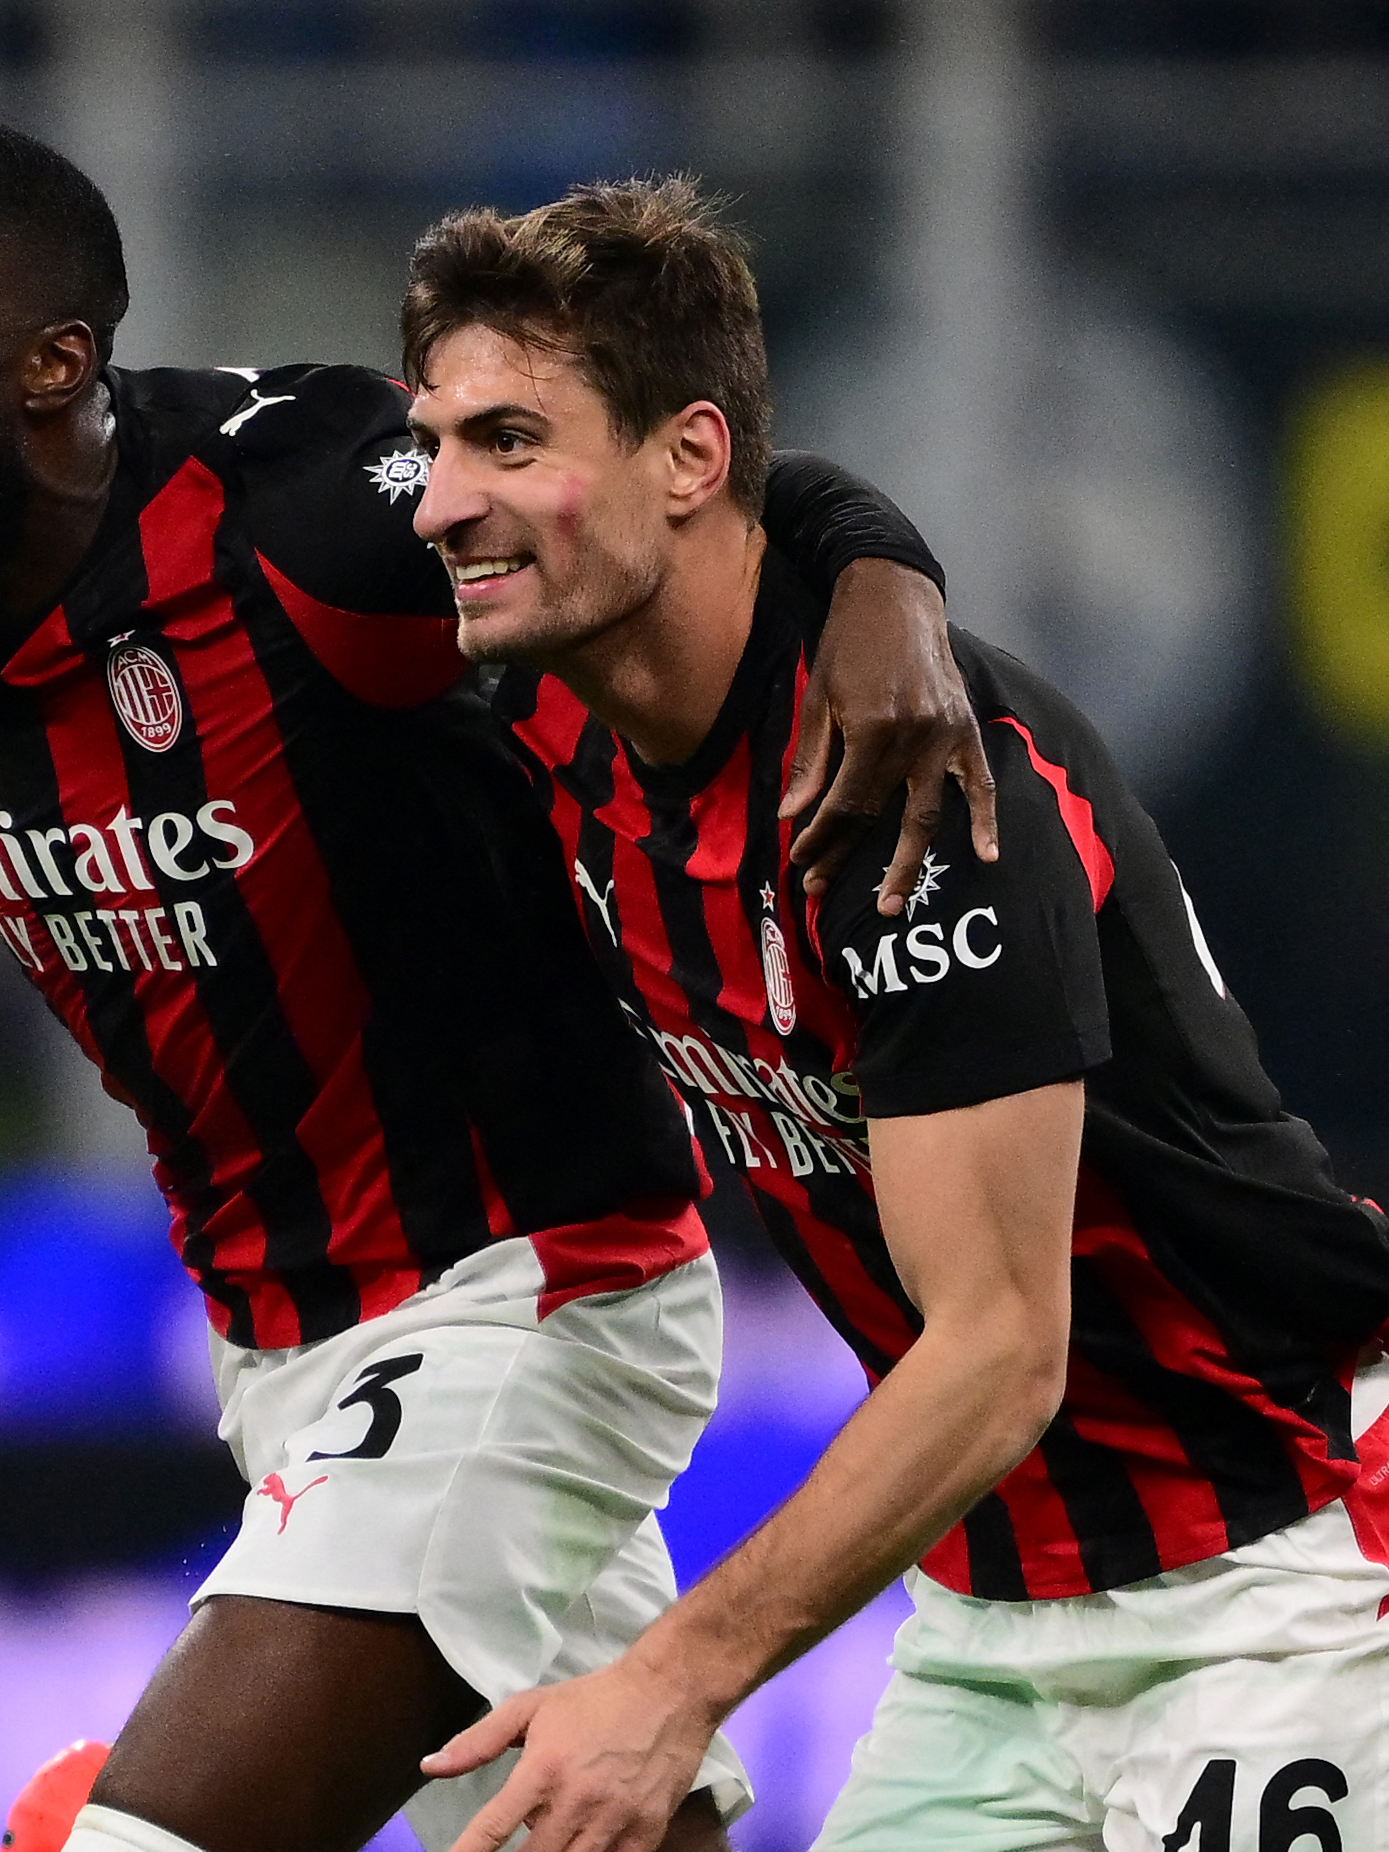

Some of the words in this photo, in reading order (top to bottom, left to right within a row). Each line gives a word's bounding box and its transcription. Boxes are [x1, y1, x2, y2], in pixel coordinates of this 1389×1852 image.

[117, 650, 154, 671] ACM
[141, 722, 171, 738] 1899
[44, 901, 217, 972] BETTER
[842, 906, 1002, 999] MSC
[305, 1353, 424, 1462] 3
